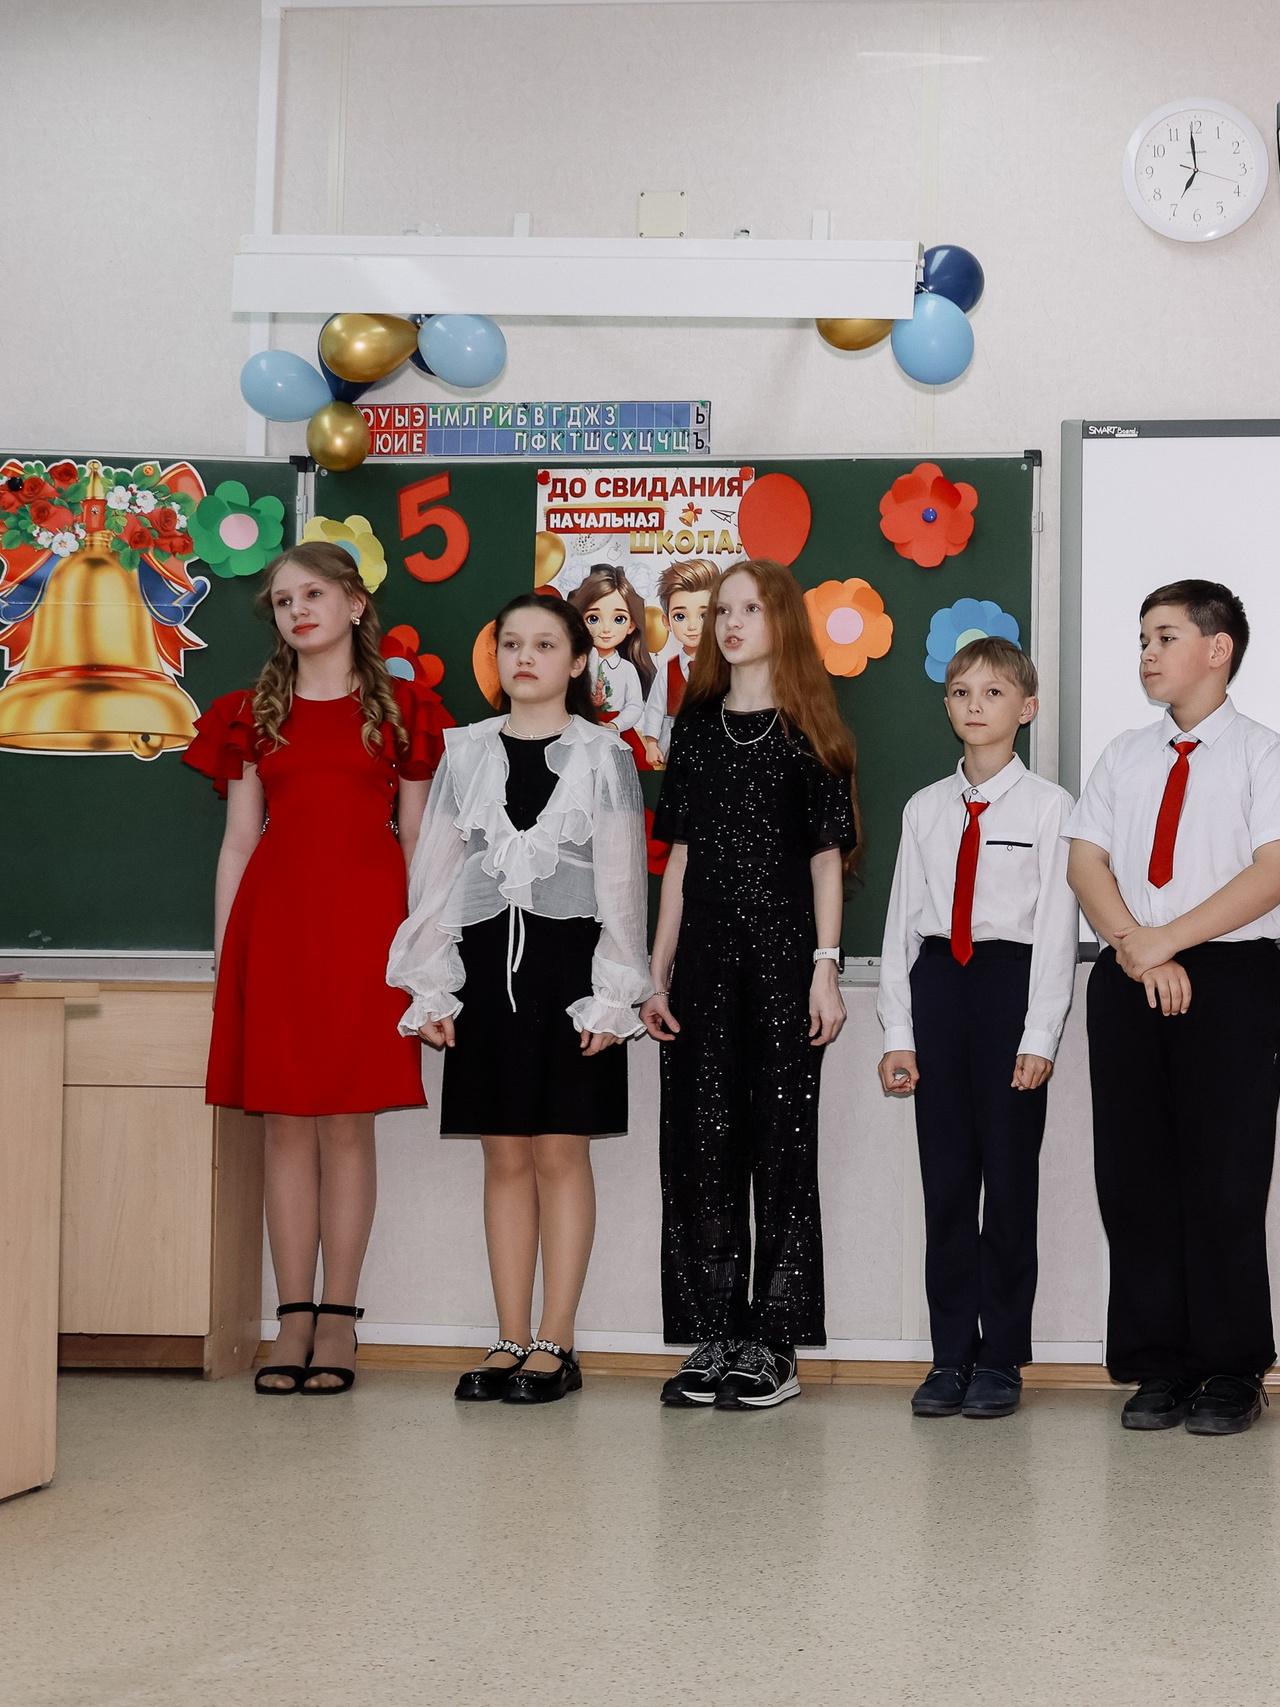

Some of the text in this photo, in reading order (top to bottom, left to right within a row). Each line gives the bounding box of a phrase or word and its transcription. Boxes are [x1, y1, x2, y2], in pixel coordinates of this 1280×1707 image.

[1168, 128, 1179, 142] 11
[1215, 126, 1221, 140] 1
[1153, 144, 1166, 158] 10
[1231, 140, 1241, 155] 2
[1145, 165, 1154, 179] 9
[1238, 162, 1248, 177] 3
[1152, 187, 1162, 201] 8
[1233, 184, 1242, 198] 4
[1170, 203, 1179, 217] 7
[1216, 201, 1224, 215] 5
[1192, 208, 1202, 223] 6
[547, 475, 744, 502] ДО СВИДАНИЯ
[397, 470, 471, 583] 5
[549, 511, 661, 529] НАЧАЛЬНАЯ
